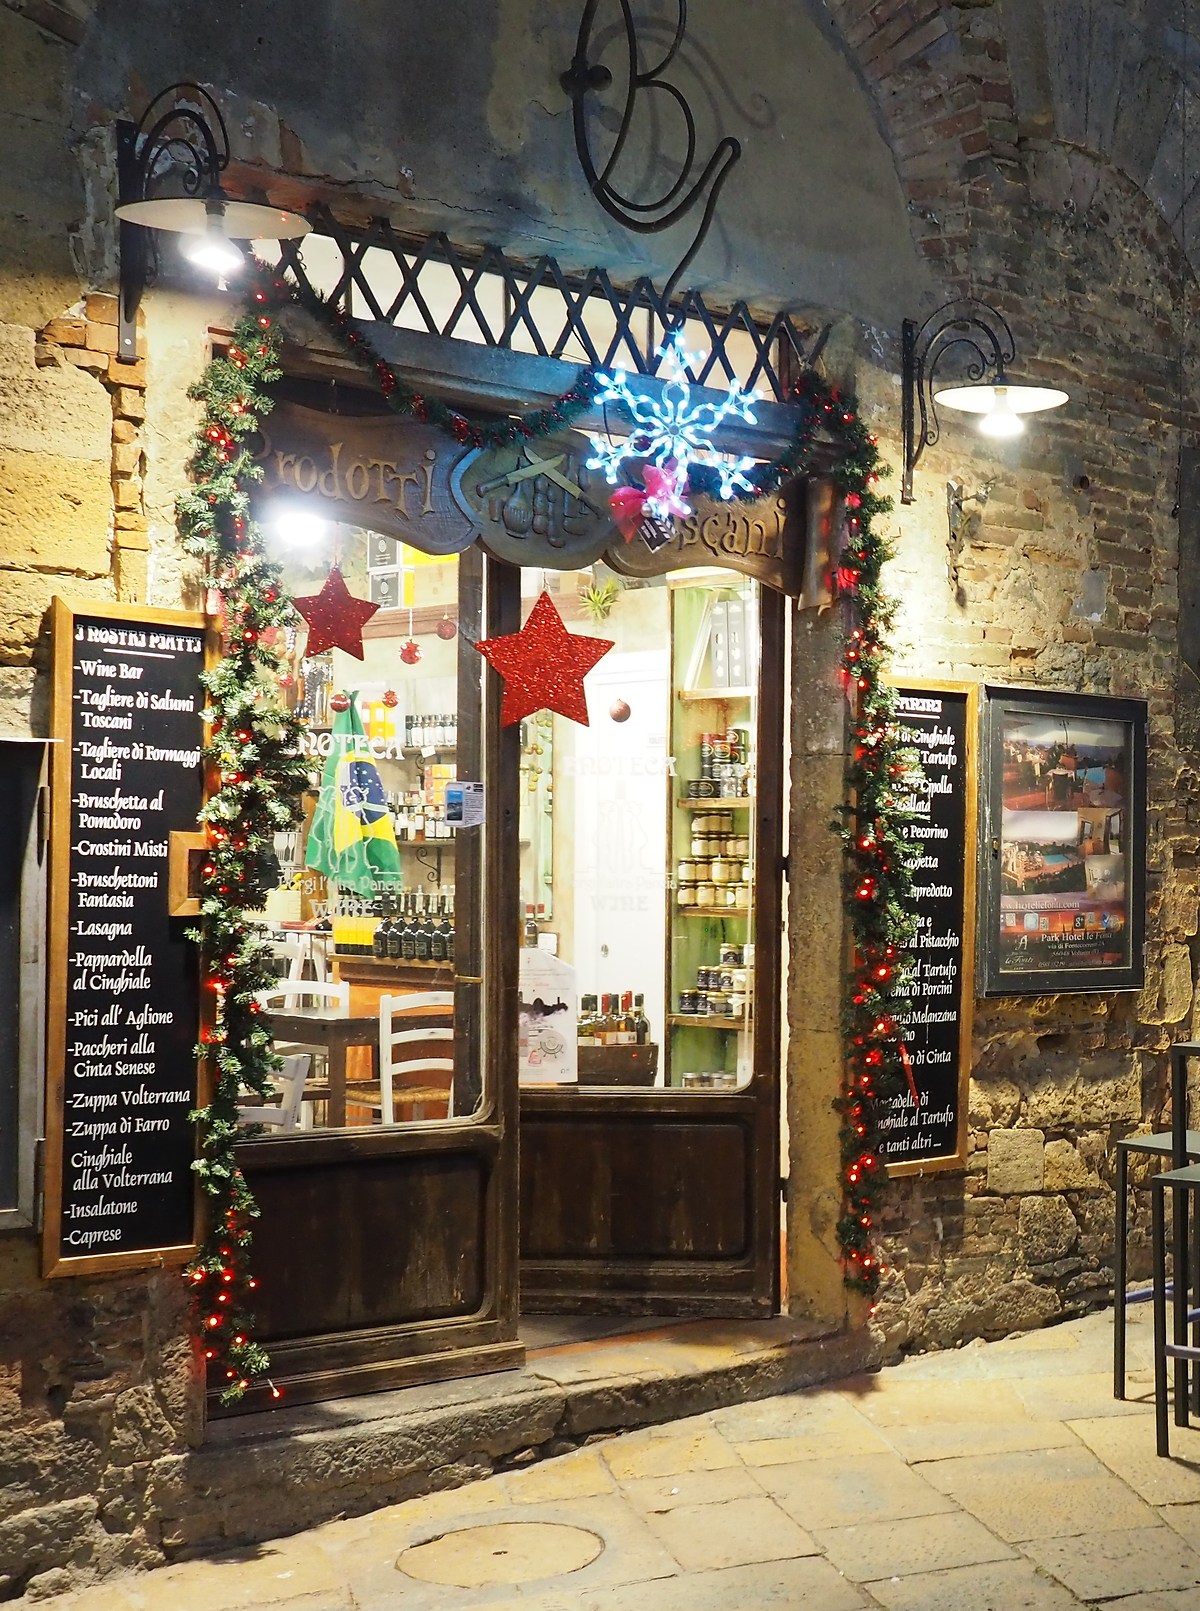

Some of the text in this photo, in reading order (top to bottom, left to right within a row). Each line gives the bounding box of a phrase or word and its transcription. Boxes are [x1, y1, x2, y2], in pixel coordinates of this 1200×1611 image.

[672, 498, 787, 561] scani
[87, 626, 146, 648] NOSTRI
[148, 632, 202, 653] PIATTI
[118, 663, 144, 679] Bar
[136, 691, 149, 709] di
[150, 688, 195, 712] Salumi
[897, 696, 942, 712] ANINI
[80, 711, 133, 730] Toscani
[912, 725, 956, 749] Cinghiale
[131, 742, 144, 760] di
[144, 745, 201, 768] Formaggi
[920, 747, 957, 770] Tartufo
[80, 759, 122, 780] Locali
[920, 774, 953, 798] Cipolla
[149, 789, 164, 811] al
[78, 812, 141, 830] Pomodoro
[902, 826, 909, 838] e
[909, 823, 949, 839] Pecorino
[133, 839, 168, 857] Misti
[360, 875, 405, 891] Pancia
[78, 891, 134, 908] Fantasia
[926, 917, 933, 927] e
[909, 930, 919, 948] al
[919, 928, 960, 949] Pistacchio
[1041, 933, 1060, 942] Park
[1062, 932, 1084, 941] Hotel
[911, 959, 922, 977] al
[922, 957, 957, 980] Tartufo
[73, 968, 151, 995] al Cinghiale
[911, 981, 921, 996] di
[922, 979, 953, 996] Porcini
[101, 1004, 123, 1026] all'
[125, 1003, 174, 1030] Aglione
[911, 1004, 957, 1024] Melanzana
[129, 1033, 155, 1054] alla
[916, 1049, 926, 1065] di
[926, 1048, 952, 1064] Cinta
[73, 1060, 156, 1078] Cinta Senese
[120, 1083, 190, 1106] Volterrana
[920, 1091, 929, 1106] di
[120, 1116, 132, 1134] di
[134, 1118, 170, 1133] Farro
[909, 1107, 920, 1127] al
[920, 1104, 954, 1127] Tartufo
[878, 1131, 932, 1154] e tanti altri
[71, 1143, 133, 1172] Cinghiale
[73, 1165, 173, 1191] alla Volterrana
